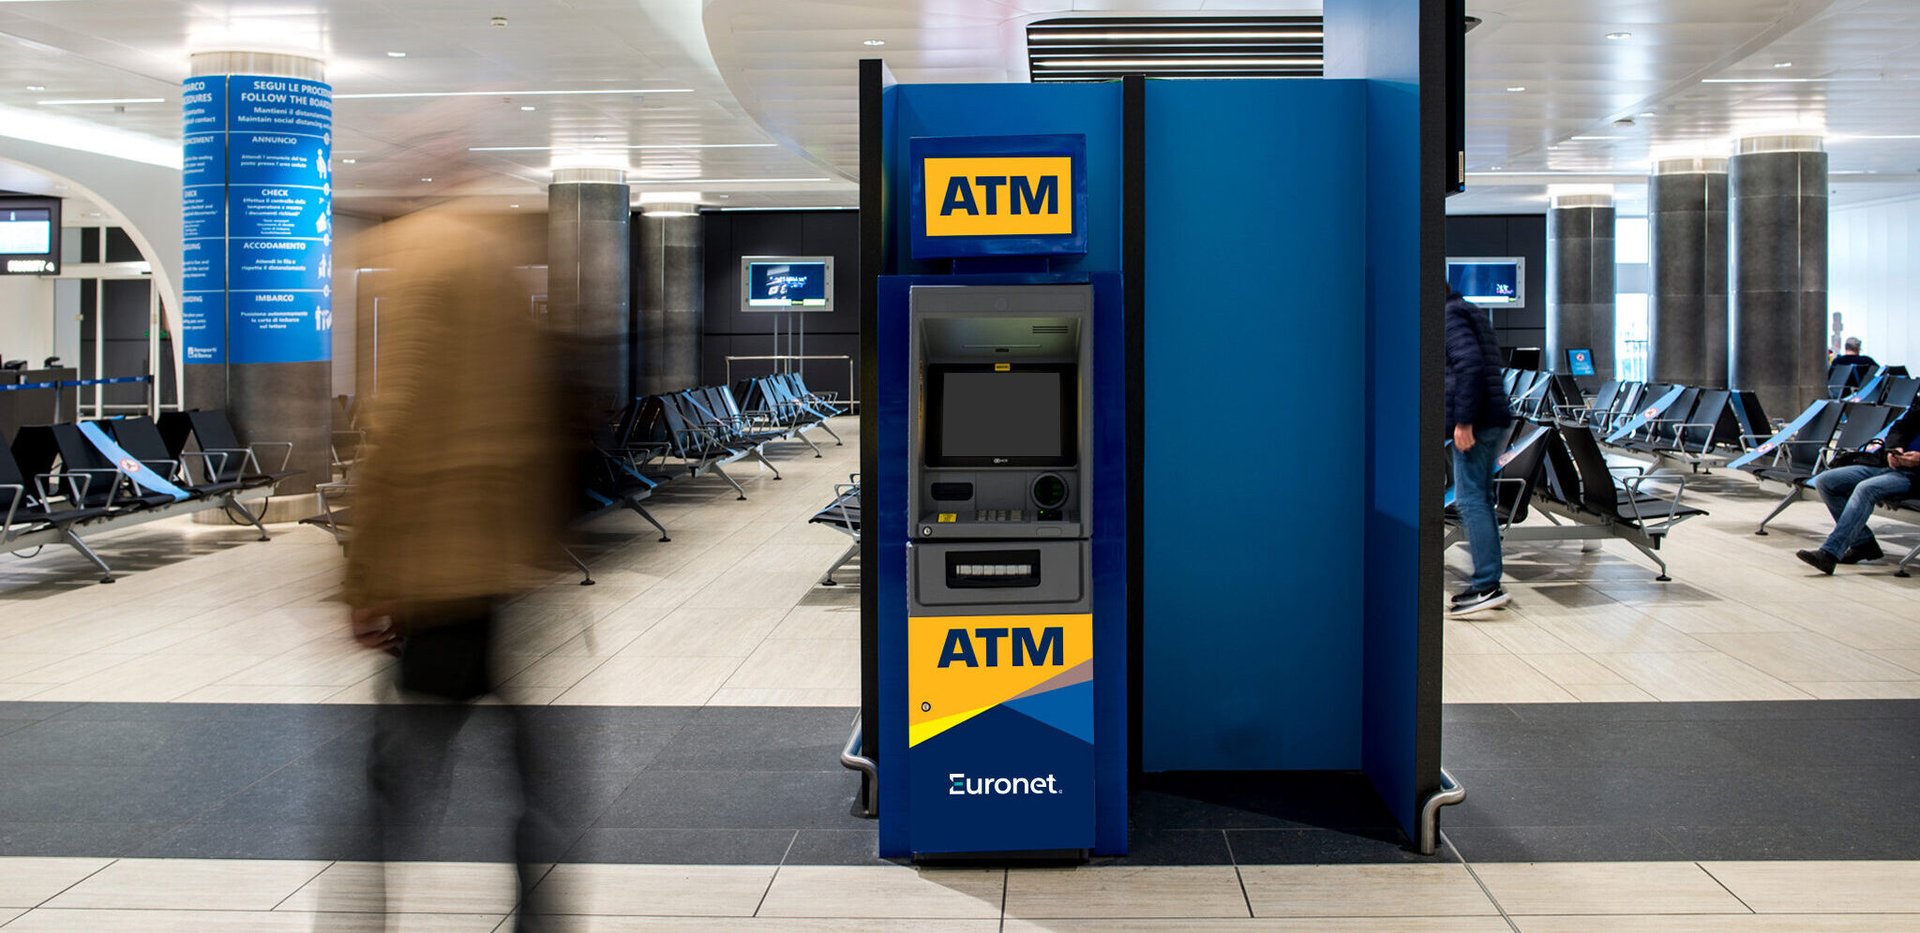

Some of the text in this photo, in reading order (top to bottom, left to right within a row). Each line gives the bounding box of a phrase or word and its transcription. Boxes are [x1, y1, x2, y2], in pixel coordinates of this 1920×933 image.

[254, 81, 286, 91] SEGUI
[289, 83, 298, 92] LE
[241, 93, 287, 103] FOLLOW
[290, 95, 307, 105] THE
[296, 118, 323, 129] distancing
[261, 189, 289, 197] CHECK
[940, 175, 1059, 216] ATM
[937, 626, 1064, 668] ATM
[949, 773, 1058, 795] Euronet
